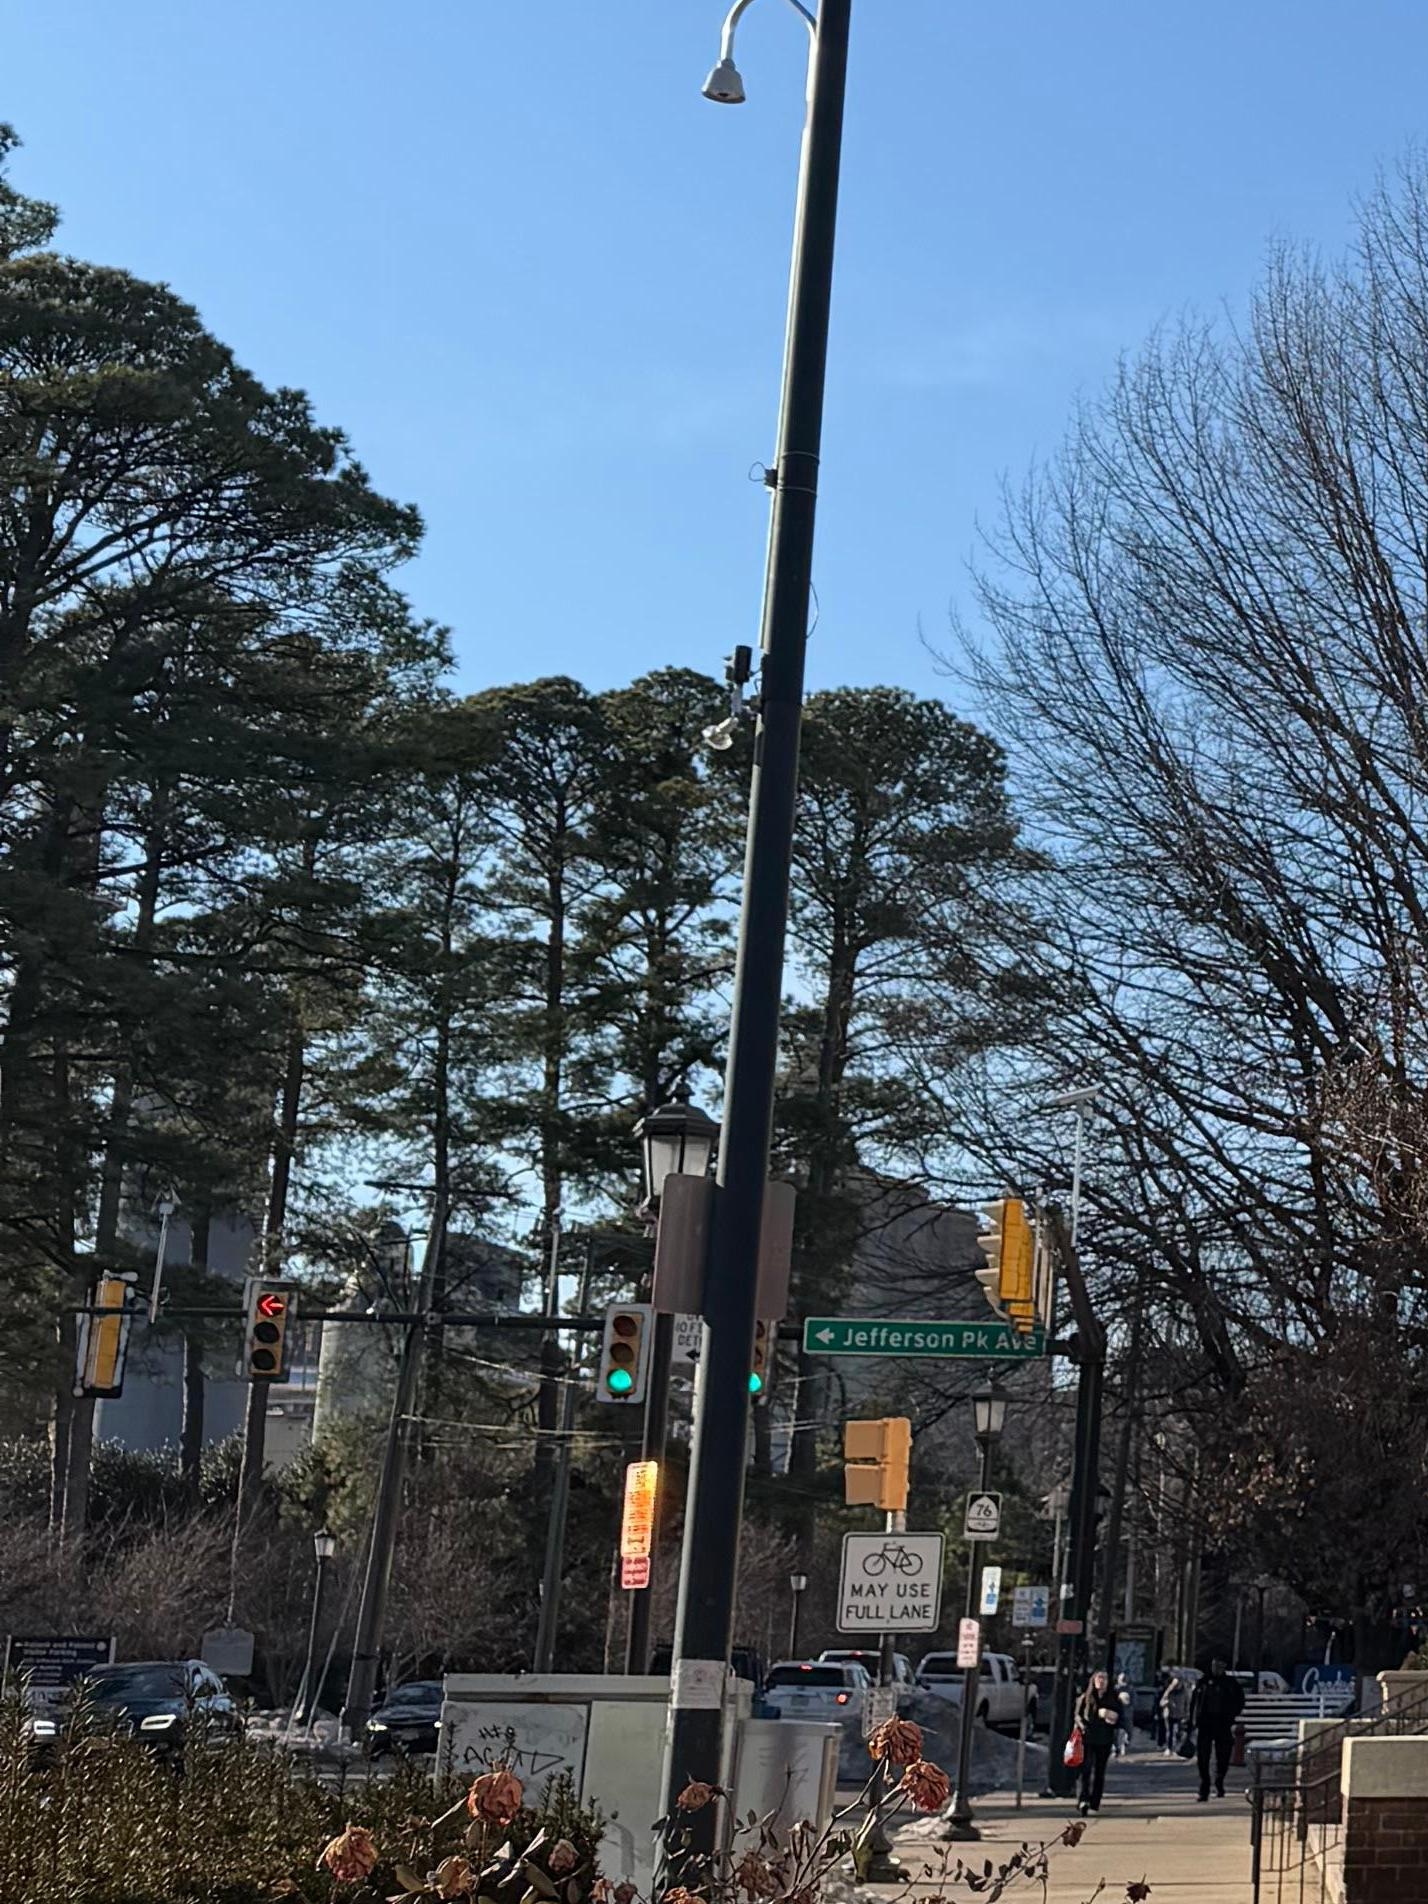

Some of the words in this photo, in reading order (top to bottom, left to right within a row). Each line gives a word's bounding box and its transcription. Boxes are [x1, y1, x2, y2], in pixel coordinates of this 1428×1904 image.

[842, 1327, 954, 1347] Jefferson
[962, 1331, 989, 1350] Pk
[996, 1333, 1037, 1351] Ave
[976, 1503, 993, 1517] 76
[850, 1583, 889, 1598] MAY
[896, 1582, 931, 1598] USE
[845, 1604, 885, 1620] FULL
[889, 1604, 933, 1620] LANE
